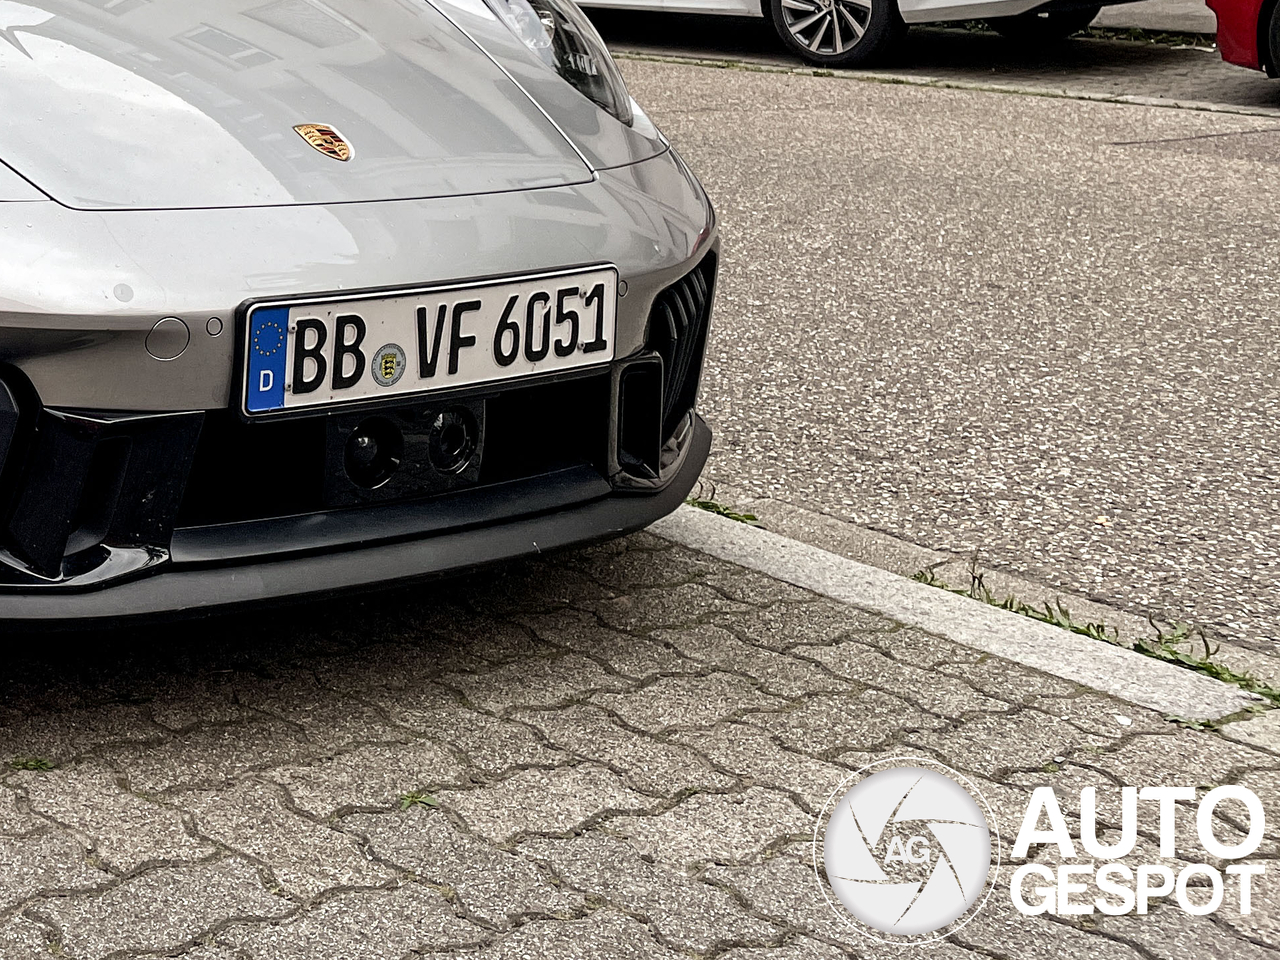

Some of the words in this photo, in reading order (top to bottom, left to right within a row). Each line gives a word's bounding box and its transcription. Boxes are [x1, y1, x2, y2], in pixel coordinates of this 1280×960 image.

[259, 369, 274, 392] D
[292, 314, 366, 395] BB
[416, 300, 481, 379] VF
[493, 283, 607, 367] 6051
